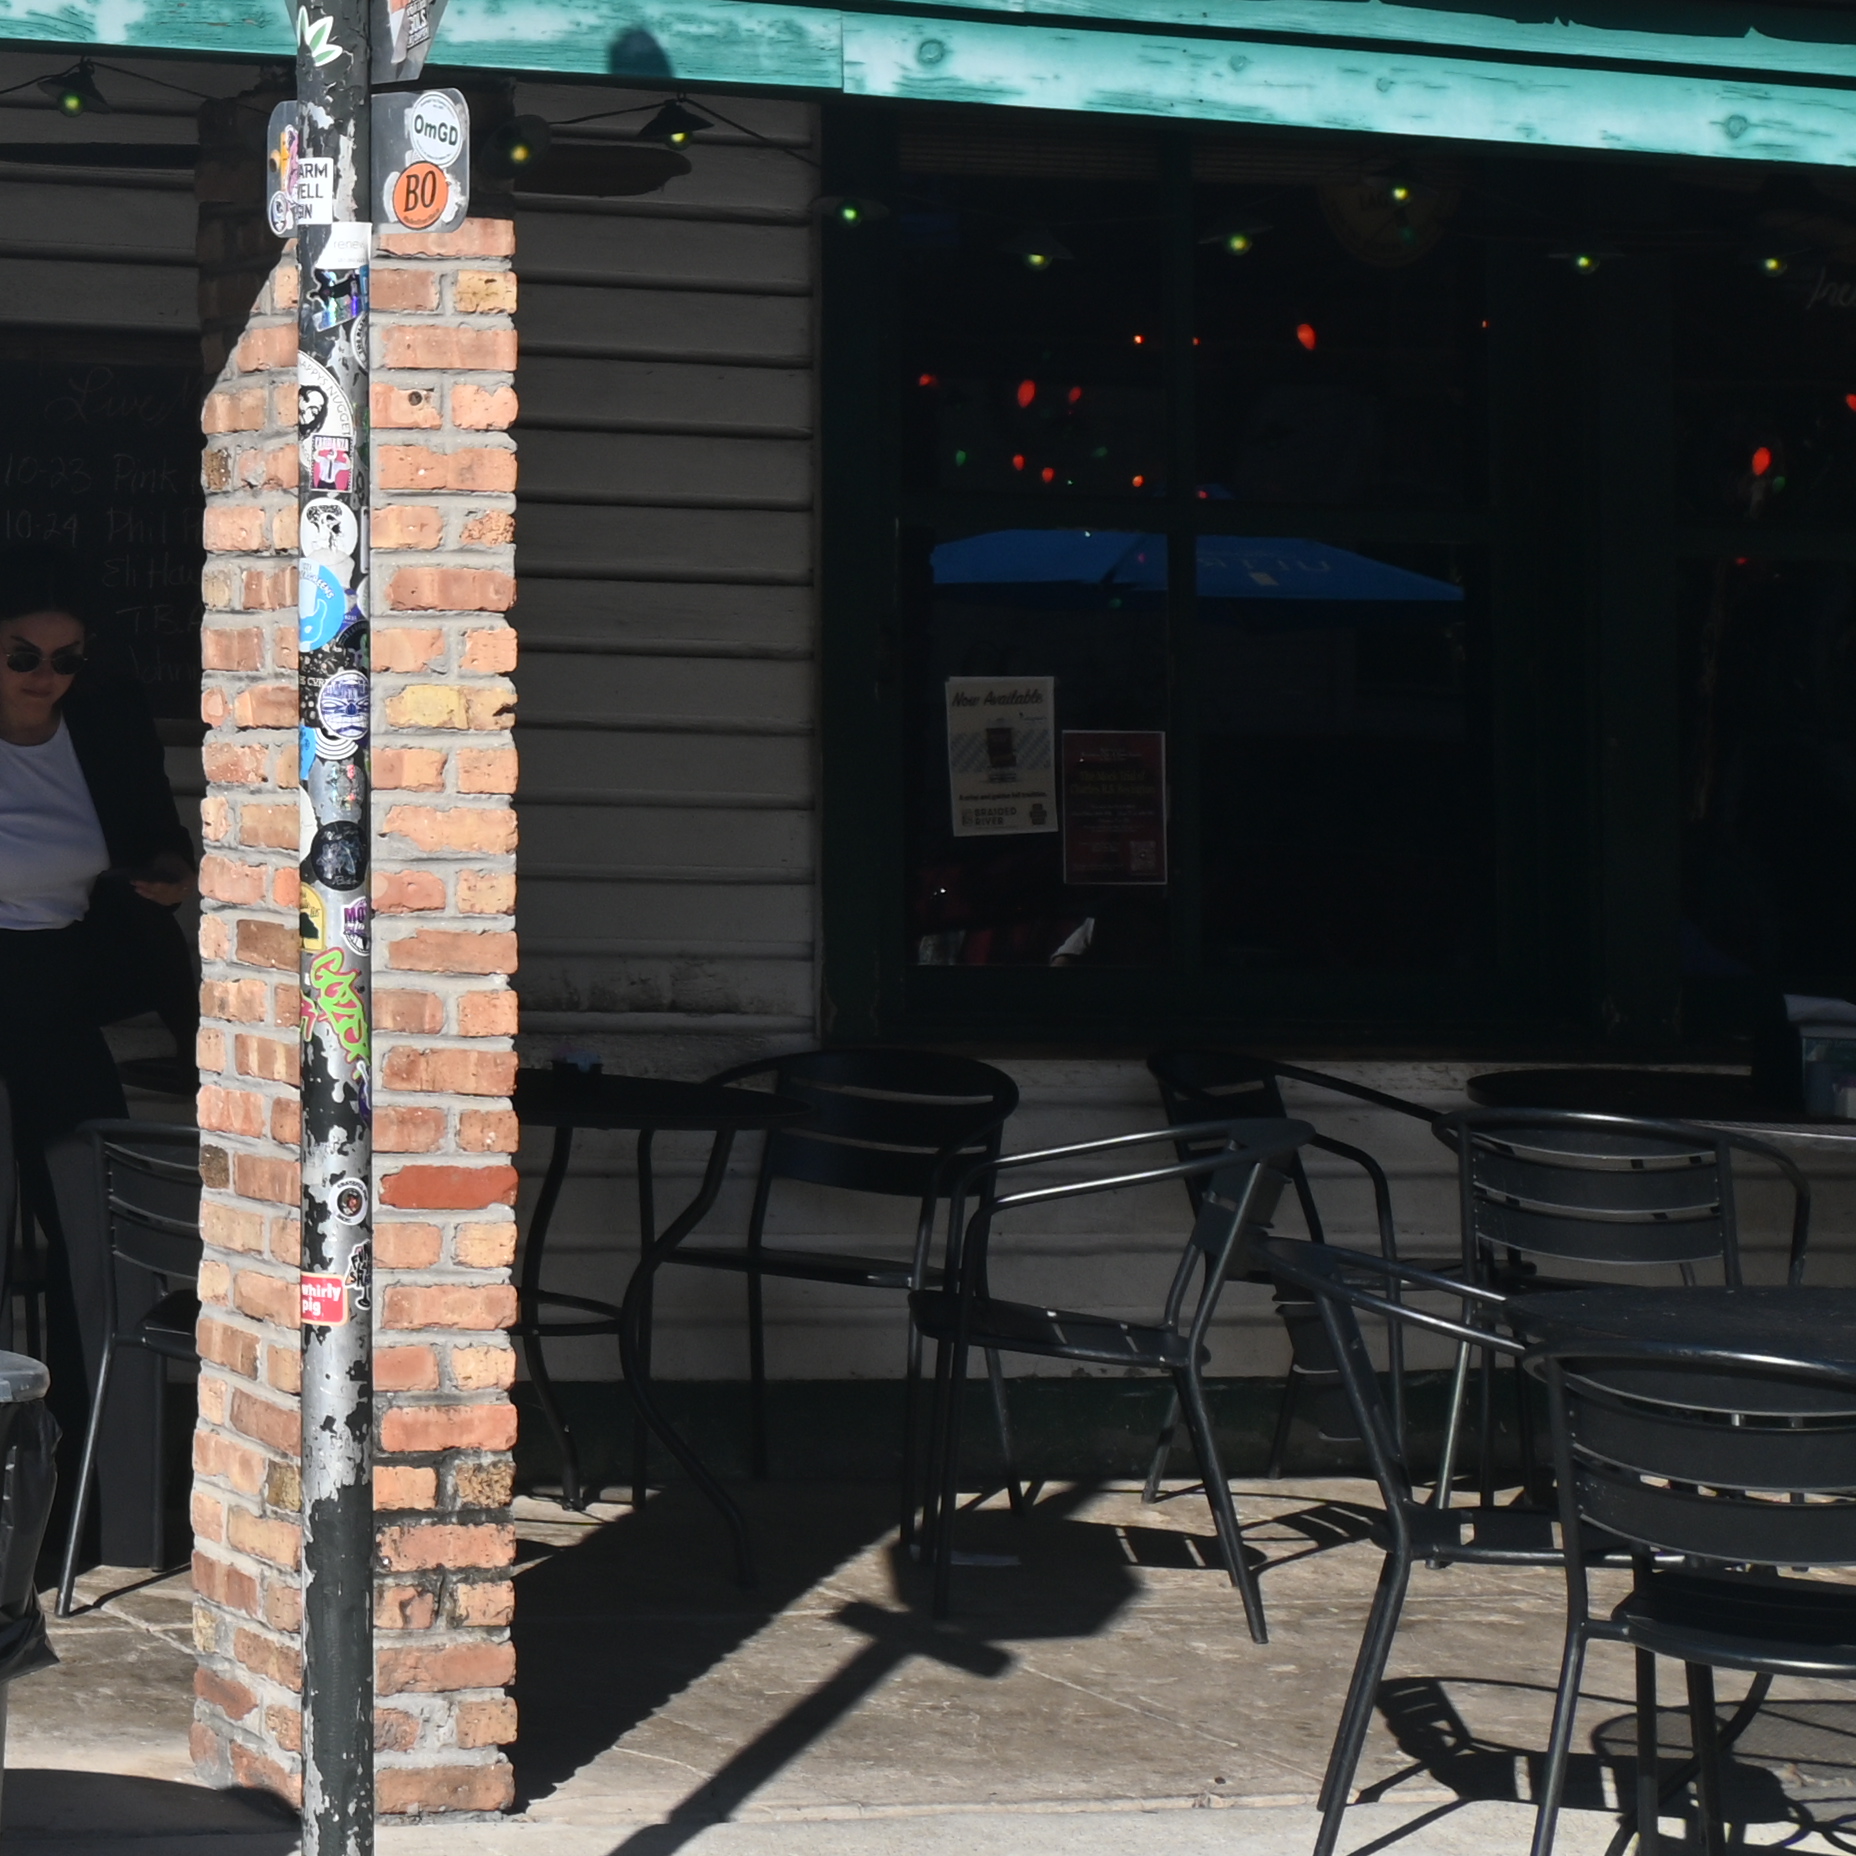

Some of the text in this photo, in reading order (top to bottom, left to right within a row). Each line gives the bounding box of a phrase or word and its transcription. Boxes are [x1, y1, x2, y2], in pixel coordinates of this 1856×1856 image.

[413, 114, 459, 147] OmGD
[298, 163, 328, 179] ARM
[296, 183, 324, 199] ELL
[403, 170, 437, 213] BO
[4, 508, 78, 548] 10-24
[107, 505, 167, 545] Phil
[951, 688, 1045, 707] Now Available
[974, 807, 1018, 817] BRAIDED
[974, 816, 1005, 826] RIVER
[302, 1297, 322, 1317] pig
